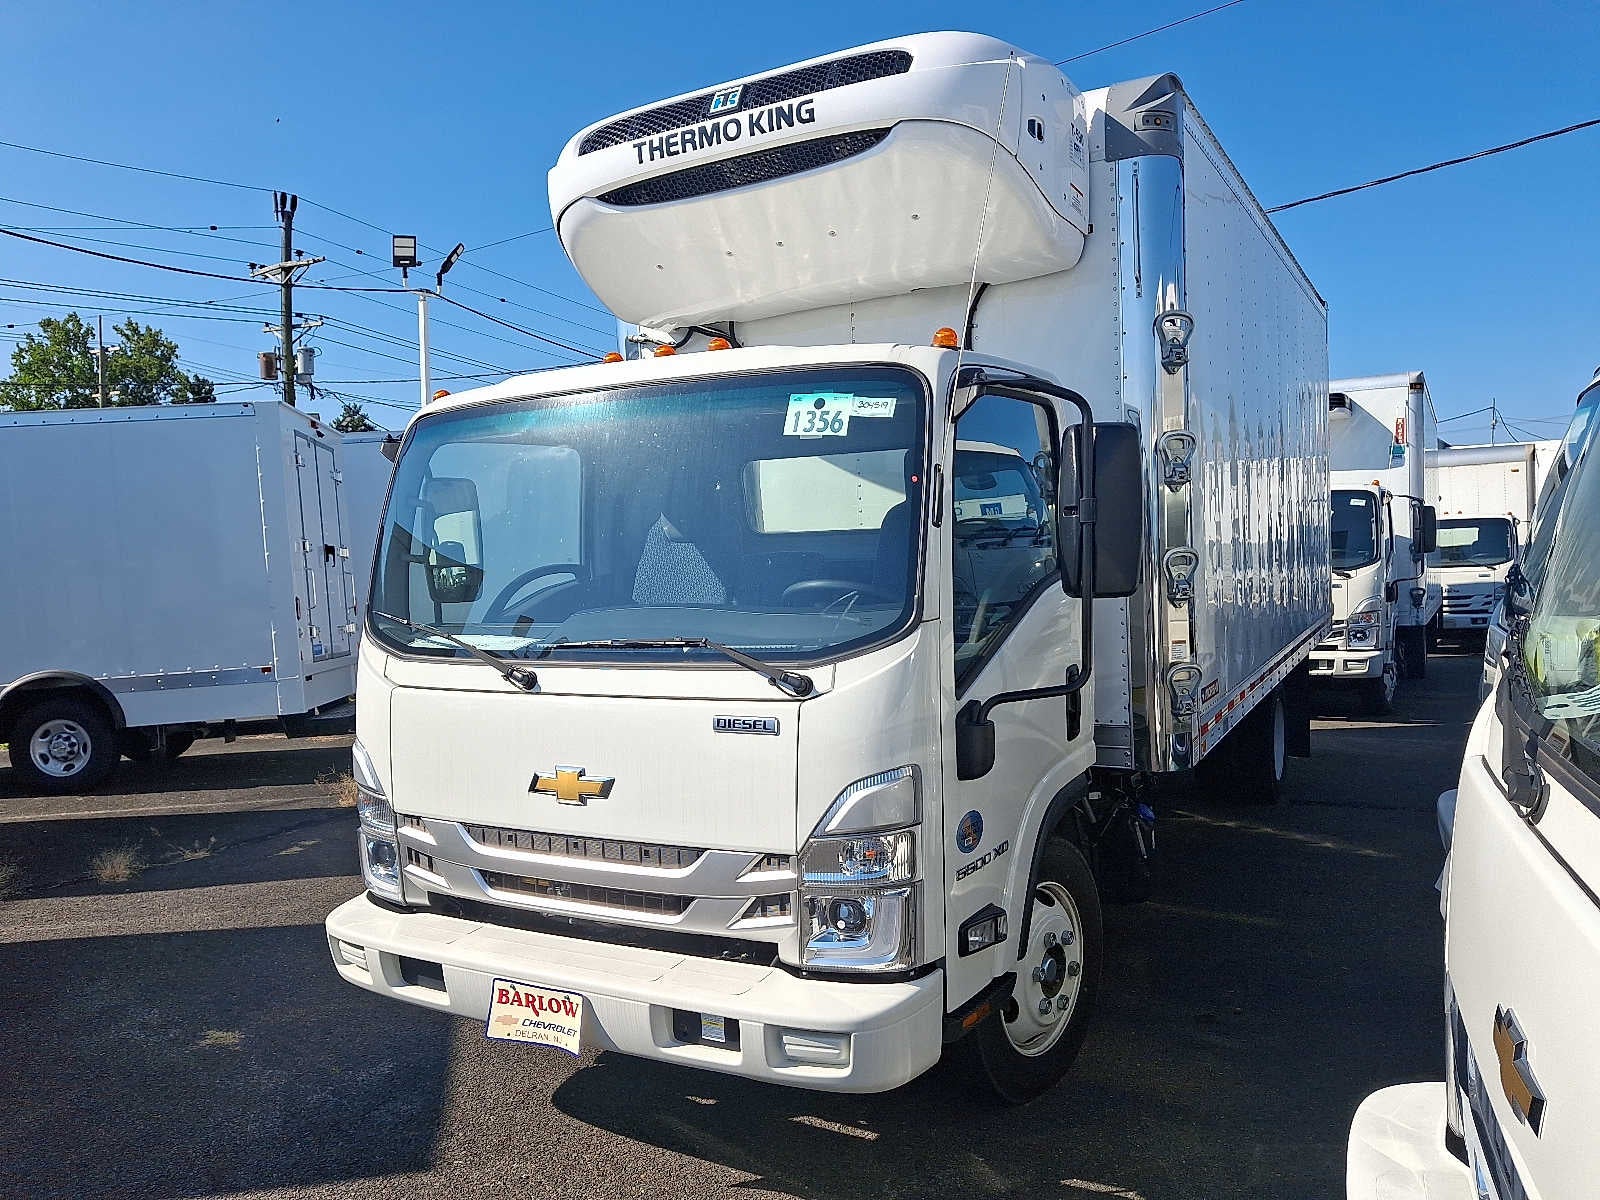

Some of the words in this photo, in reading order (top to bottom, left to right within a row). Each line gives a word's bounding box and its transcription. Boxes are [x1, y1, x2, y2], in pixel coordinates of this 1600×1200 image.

[633, 118, 741, 164] THERMO
[748, 99, 815, 137] KING
[792, 410, 845, 434] 1356
[716, 718, 774, 731] DIESEL
[496, 988, 579, 1018] BARLOW
[521, 1018, 578, 1038] CHEVROLET
